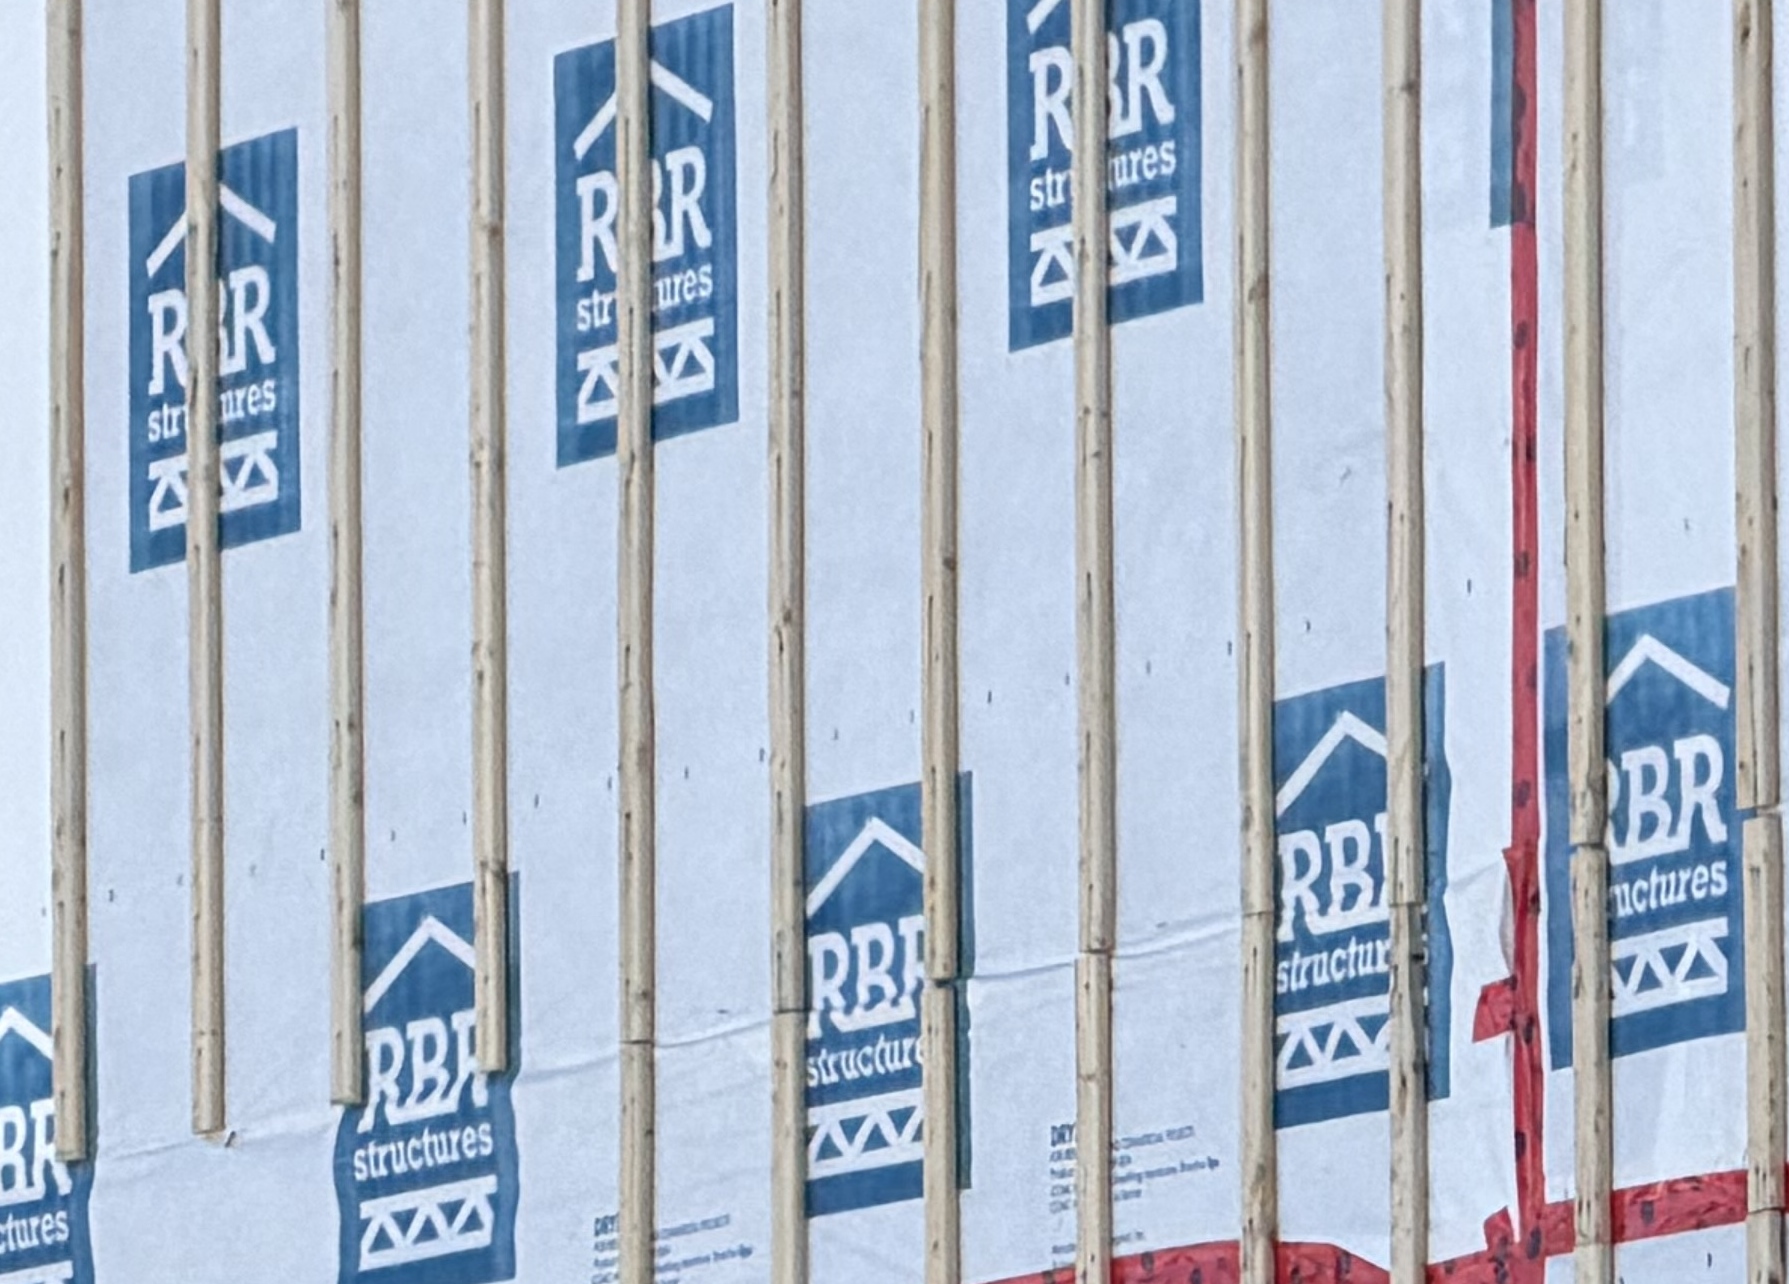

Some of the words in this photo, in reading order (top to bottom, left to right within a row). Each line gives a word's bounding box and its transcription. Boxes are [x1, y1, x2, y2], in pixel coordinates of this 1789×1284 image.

[1030, 137, 1176, 212] strures
[575, 262, 713, 332] strures
[148, 379, 278, 443] strures
[1606, 733, 1728, 846] BR
[1609, 861, 1728, 917] uctures
[1277, 936, 1392, 994] structur
[807, 1034, 925, 1089] structur
[0, 1098, 73, 1207] BR
[352, 1122, 493, 1180] structures
